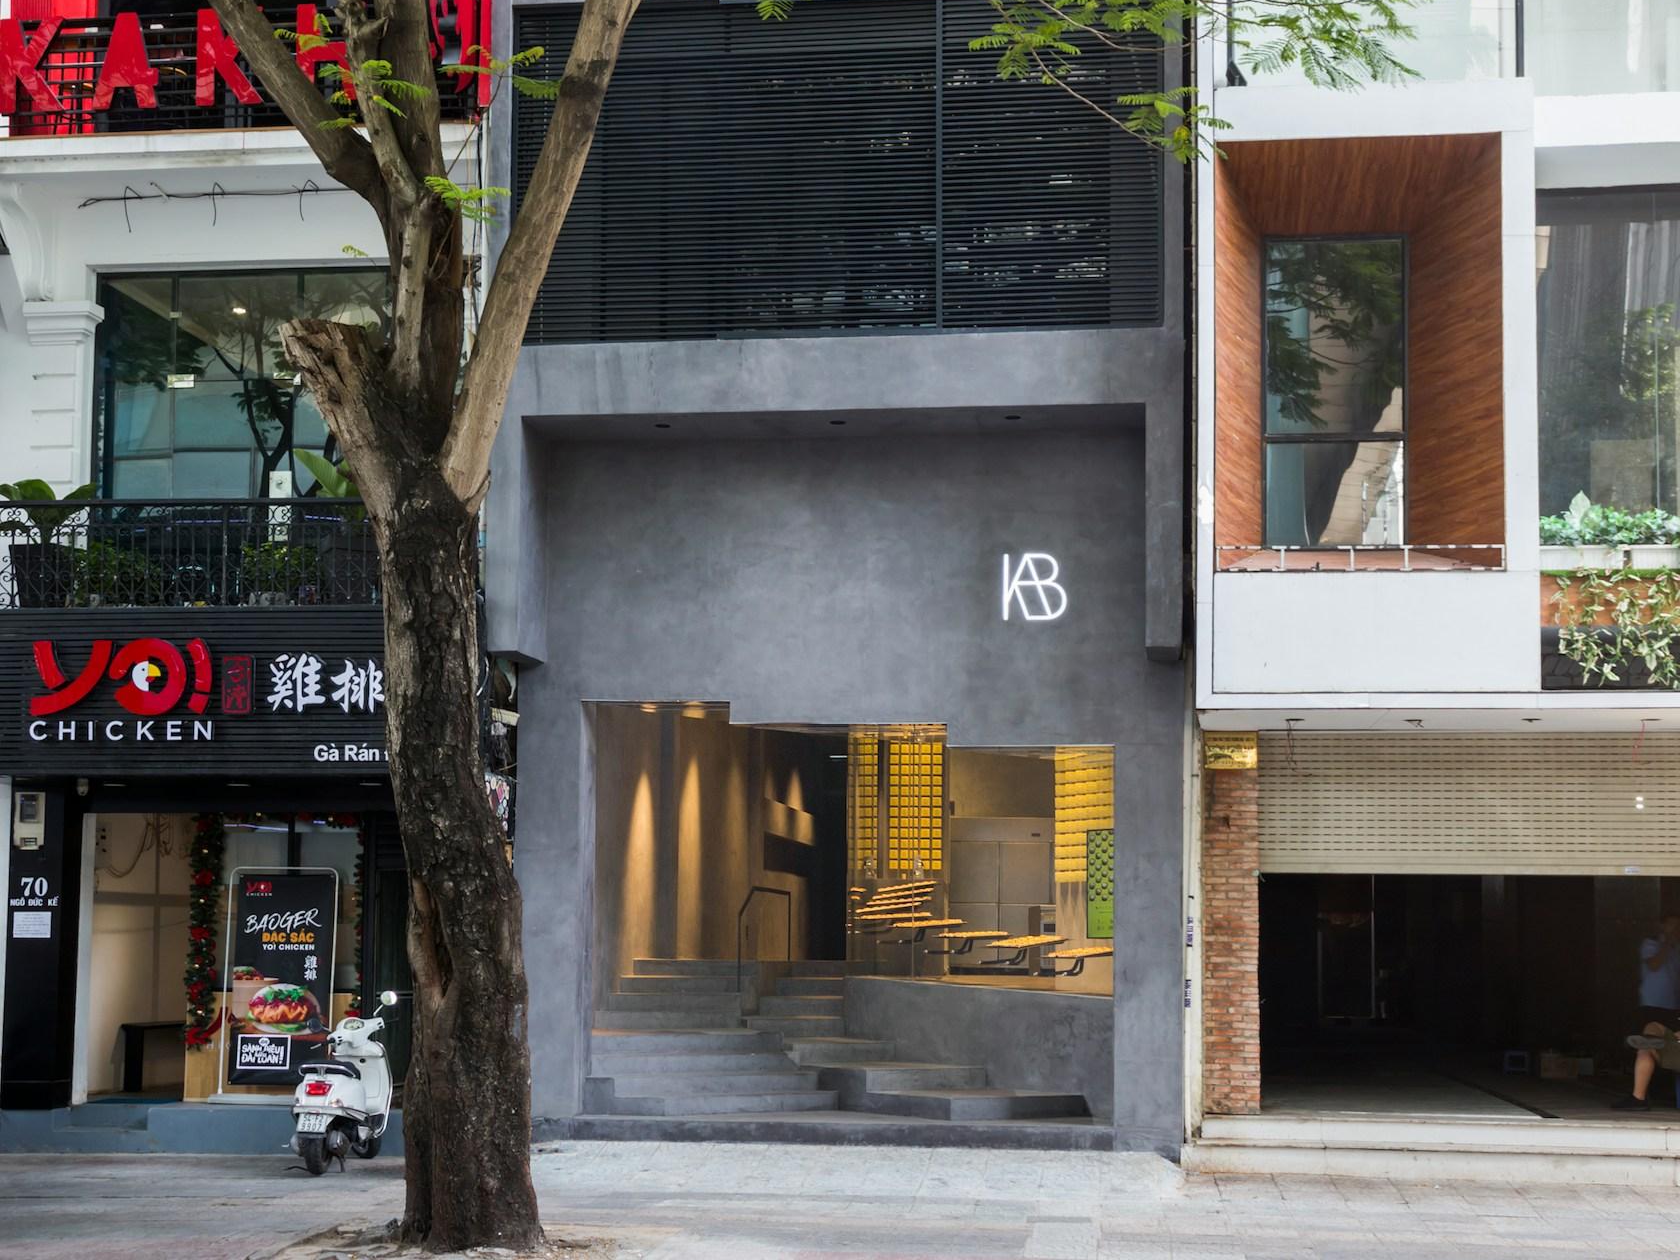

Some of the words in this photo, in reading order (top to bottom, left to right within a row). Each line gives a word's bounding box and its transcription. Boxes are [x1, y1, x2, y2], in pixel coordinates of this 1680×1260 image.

[266, 652, 386, 713] 雞排
[29, 720, 213, 741] CHICKEN
[314, 743, 340, 762] Gà
[344, 743, 380, 762] Rán
[20, 877, 49, 897] 70
[244, 908, 322, 934] BAOGER
[278, 943, 315, 951] CHICKEN
